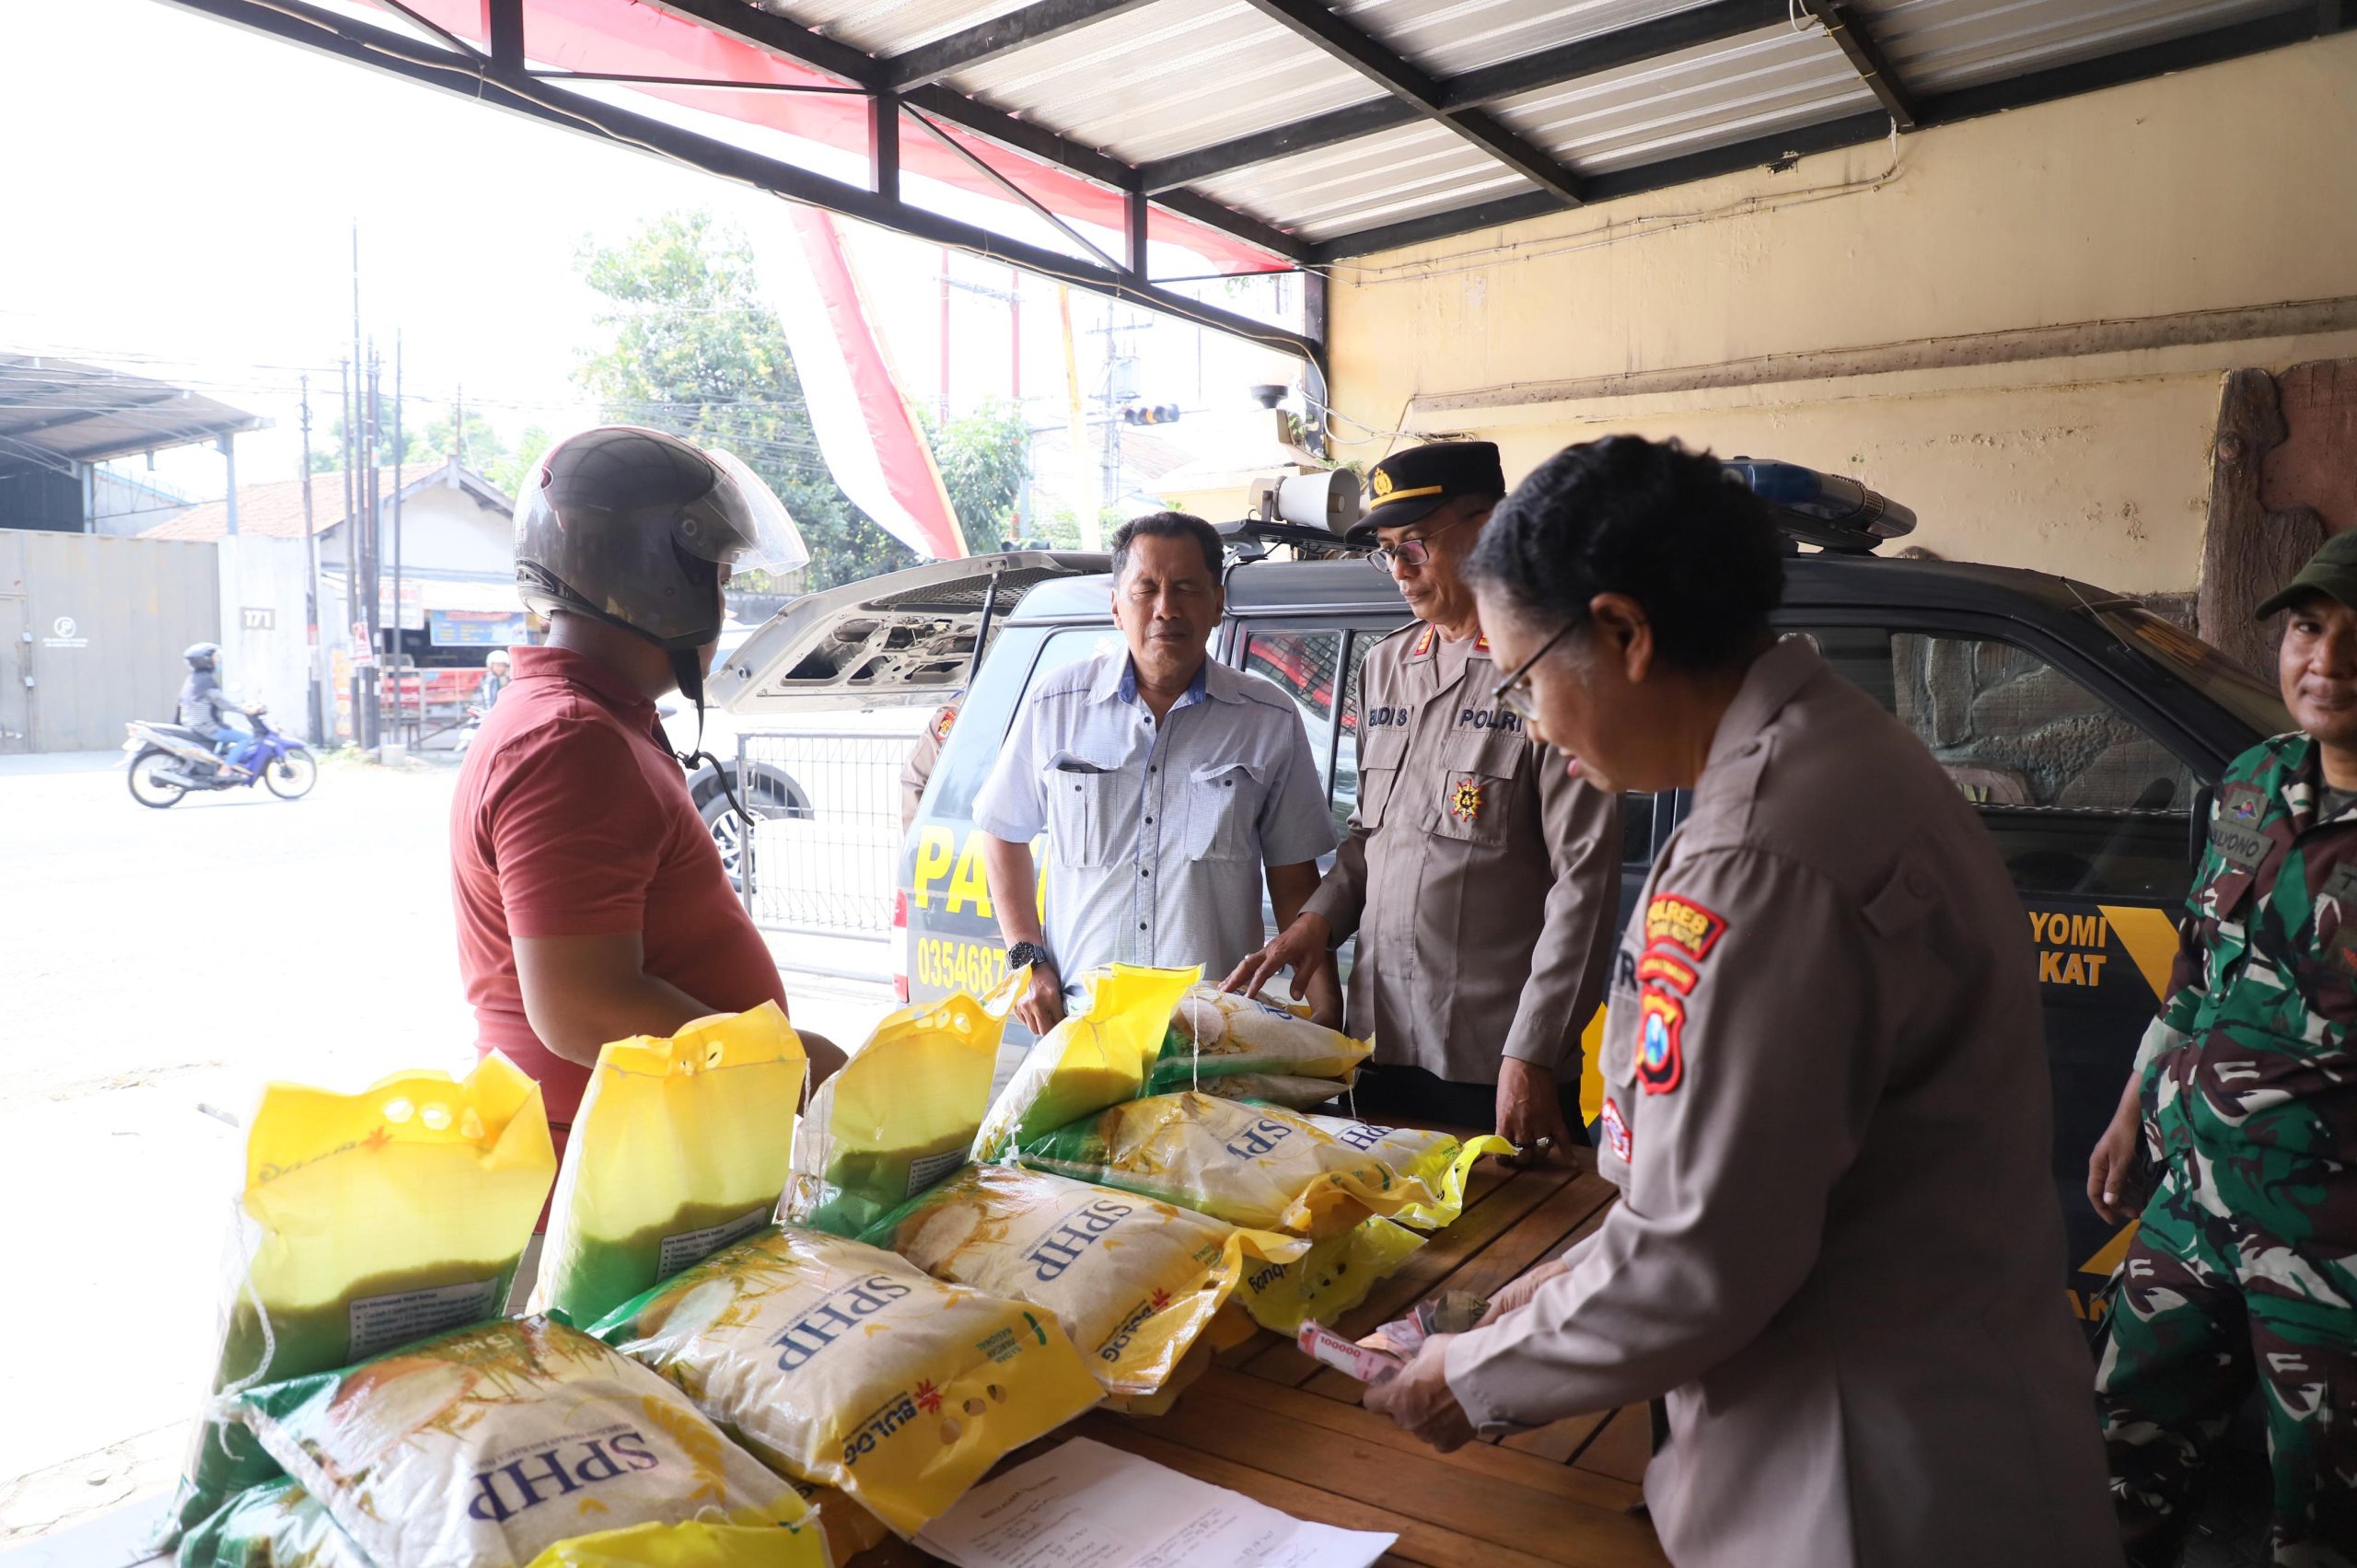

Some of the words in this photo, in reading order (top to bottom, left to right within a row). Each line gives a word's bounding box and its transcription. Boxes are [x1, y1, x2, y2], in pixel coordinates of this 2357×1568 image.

[244, 610, 272, 627] 171
[1368, 706, 1396, 727] BUDI
[1458, 709, 1523, 733] POLRI
[1027, 1199, 1133, 1282] SPHP
[771, 1275, 912, 1372] SPHP
[1319, 1336, 1363, 1358] 100000
[843, 1398, 919, 1467] BULOG
[468, 1431, 659, 1524] SPHP
